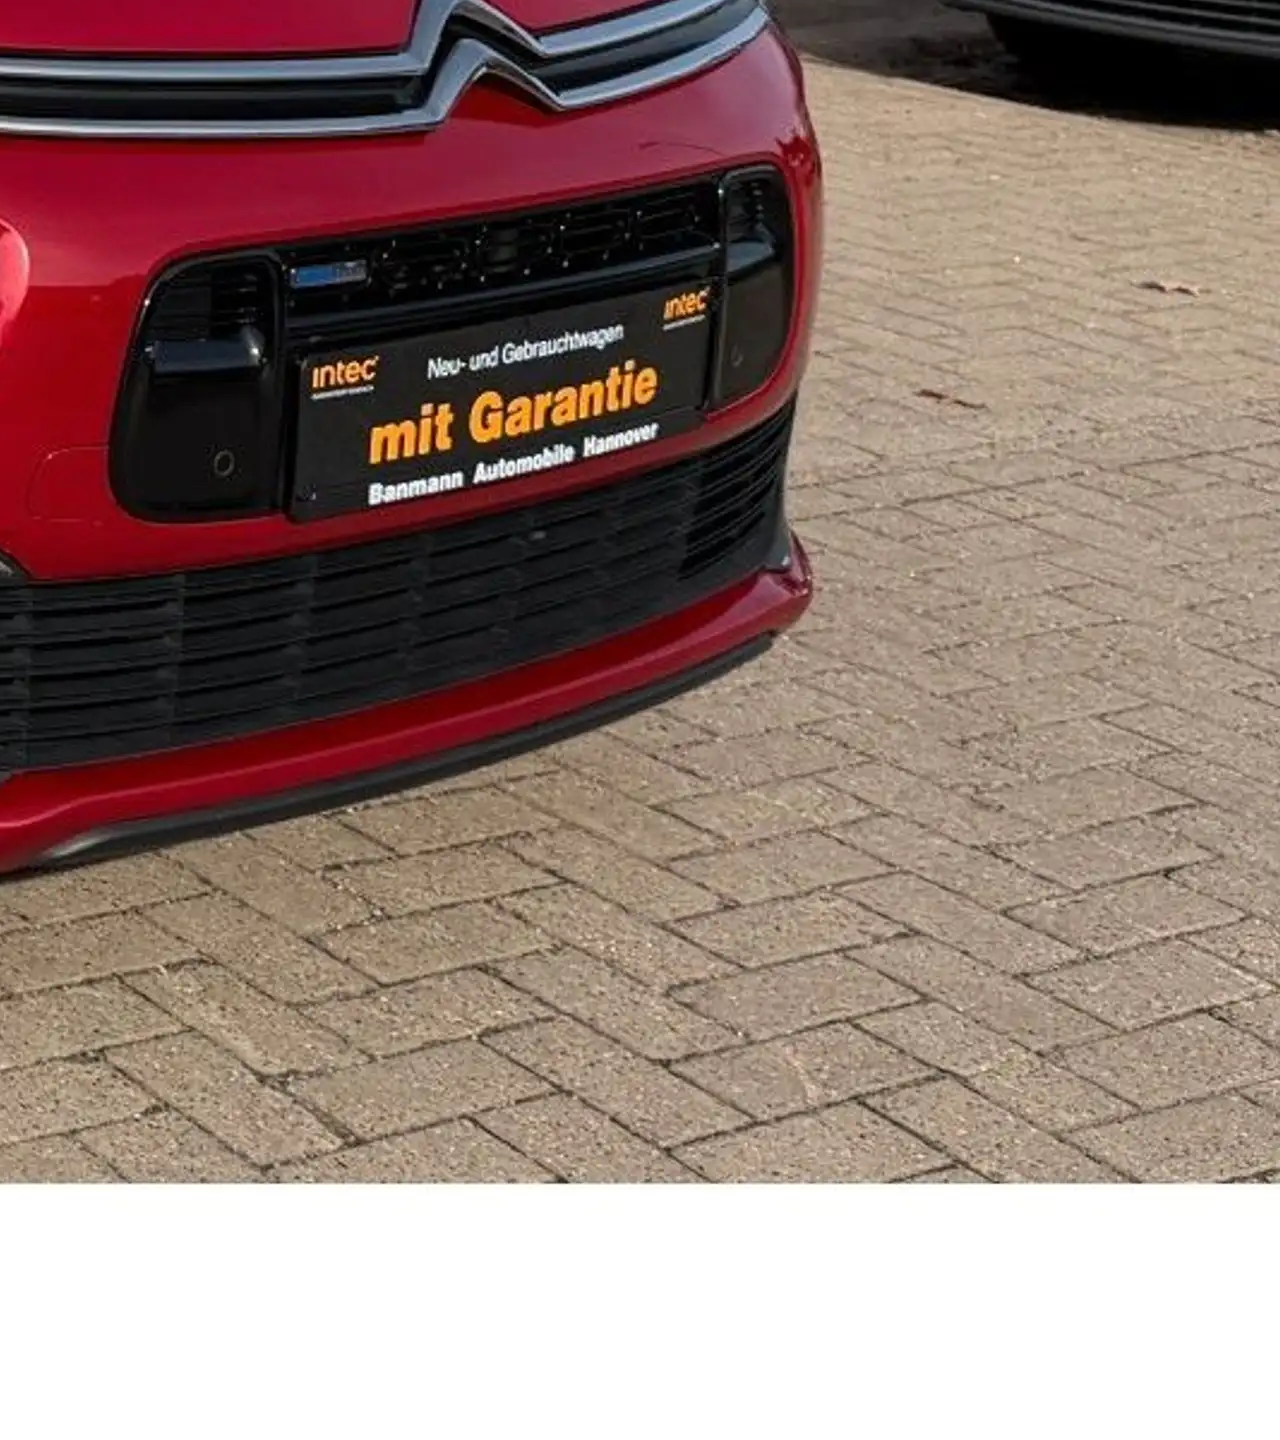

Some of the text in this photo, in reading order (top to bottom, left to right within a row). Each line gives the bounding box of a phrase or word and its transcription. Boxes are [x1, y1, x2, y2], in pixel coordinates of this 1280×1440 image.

[426, 324, 624, 380] Neu- und Gebrauchtwagen
[369, 360, 658, 464] mit Garantie
[368, 422, 660, 505] Banmann Automobile Hannover
